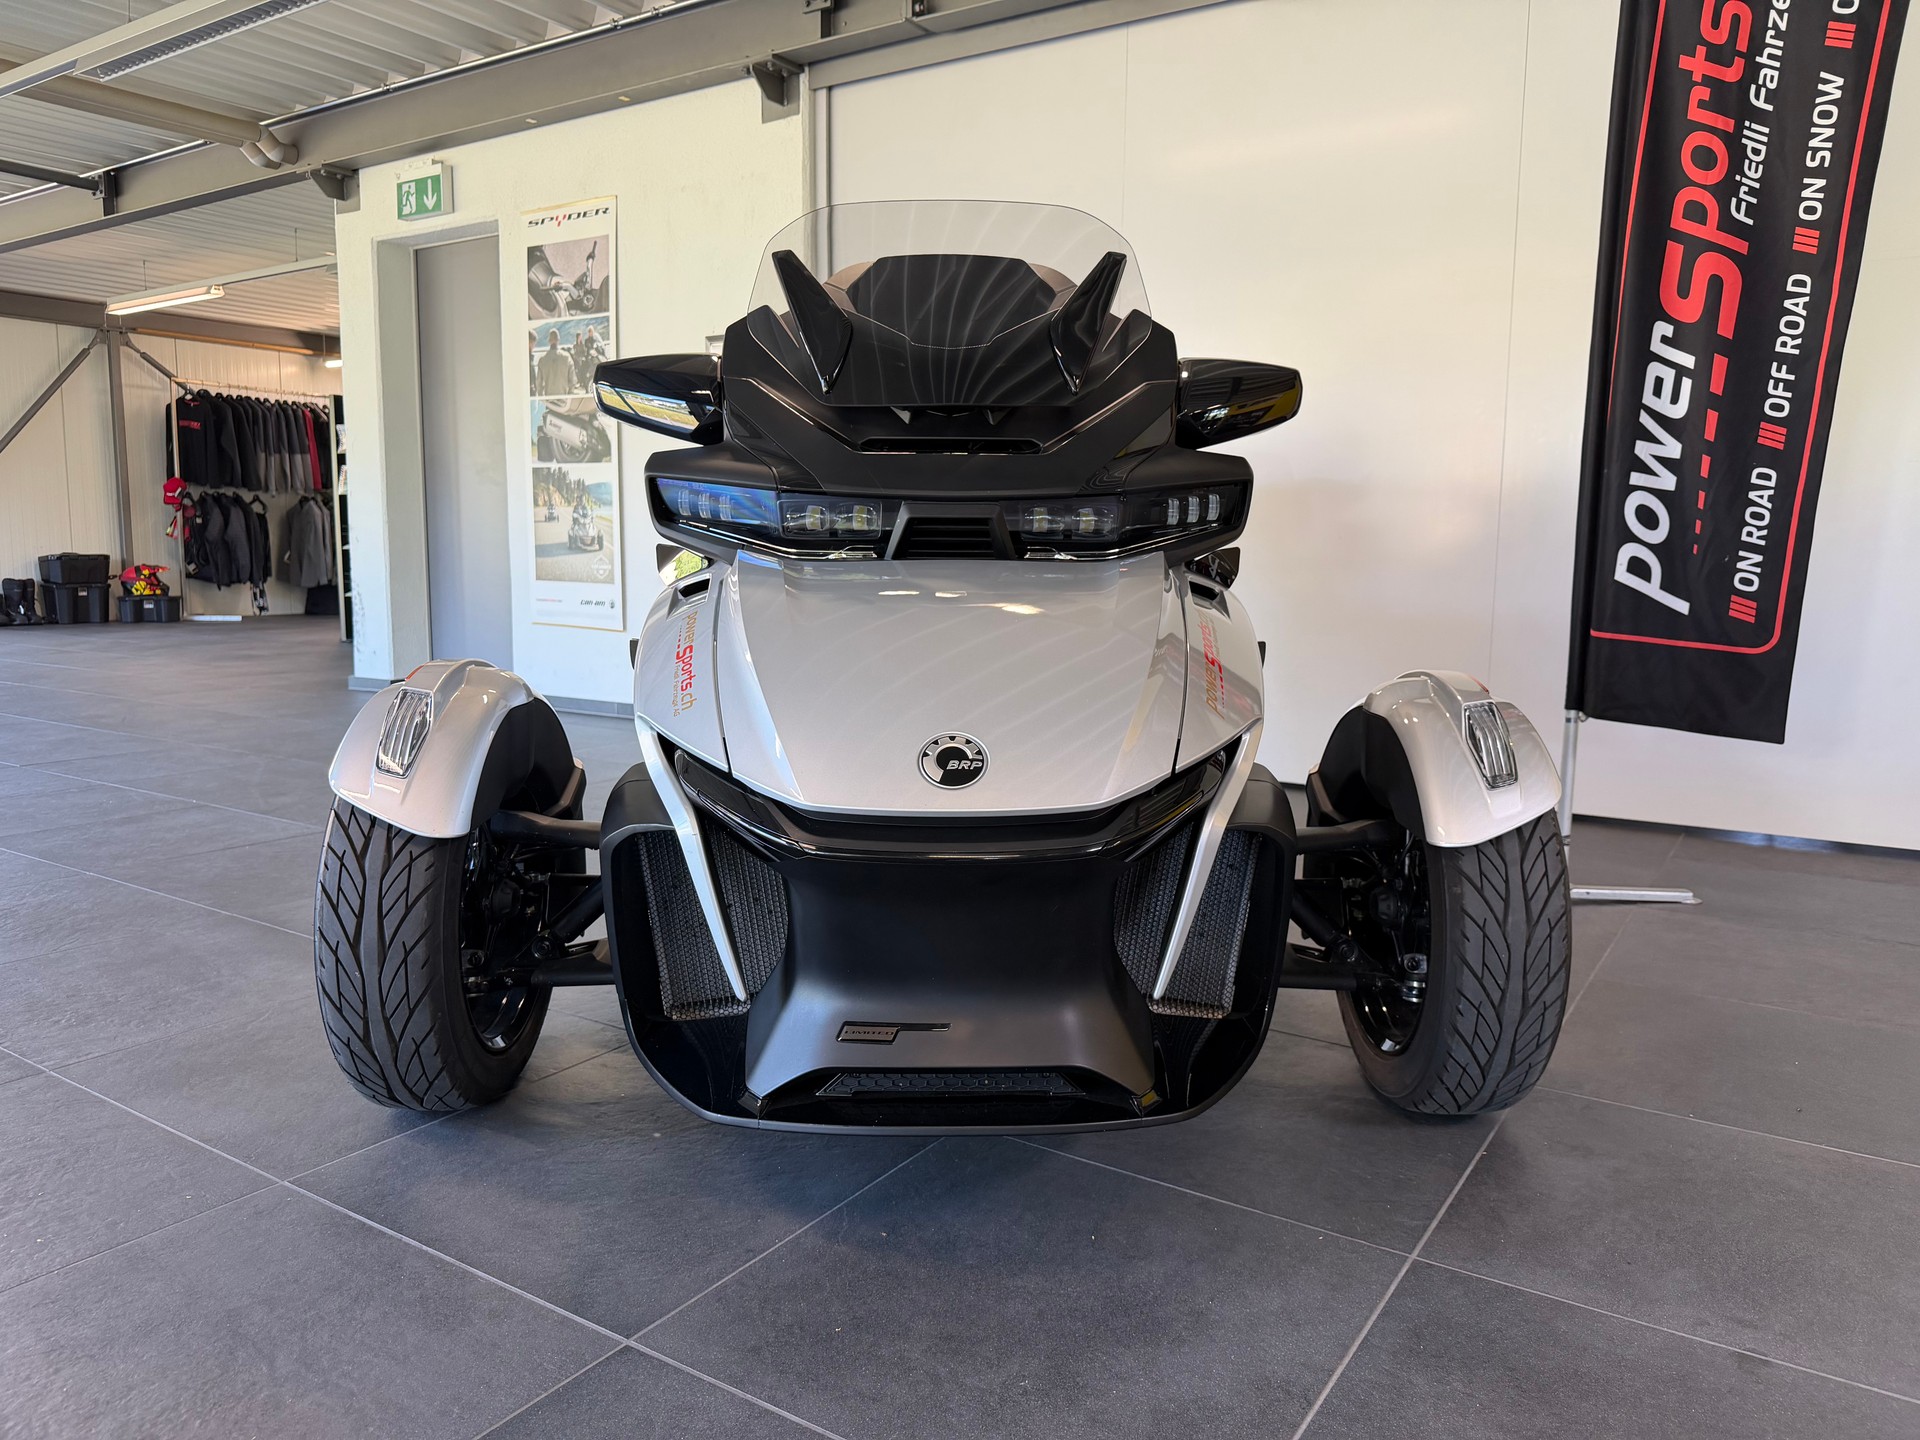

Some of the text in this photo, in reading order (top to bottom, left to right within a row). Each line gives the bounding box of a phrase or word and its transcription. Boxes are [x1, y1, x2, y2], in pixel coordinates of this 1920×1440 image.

[1730, 120, 1770, 226] Friedli
[1798, 71, 1845, 221] ON SNOW
[527, 207, 610, 228] SPYDER
[1764, 273, 1812, 418] OFF ROAD
[1733, 466, 1778, 592] ON ROAD
[946, 759, 983, 770] BRP
